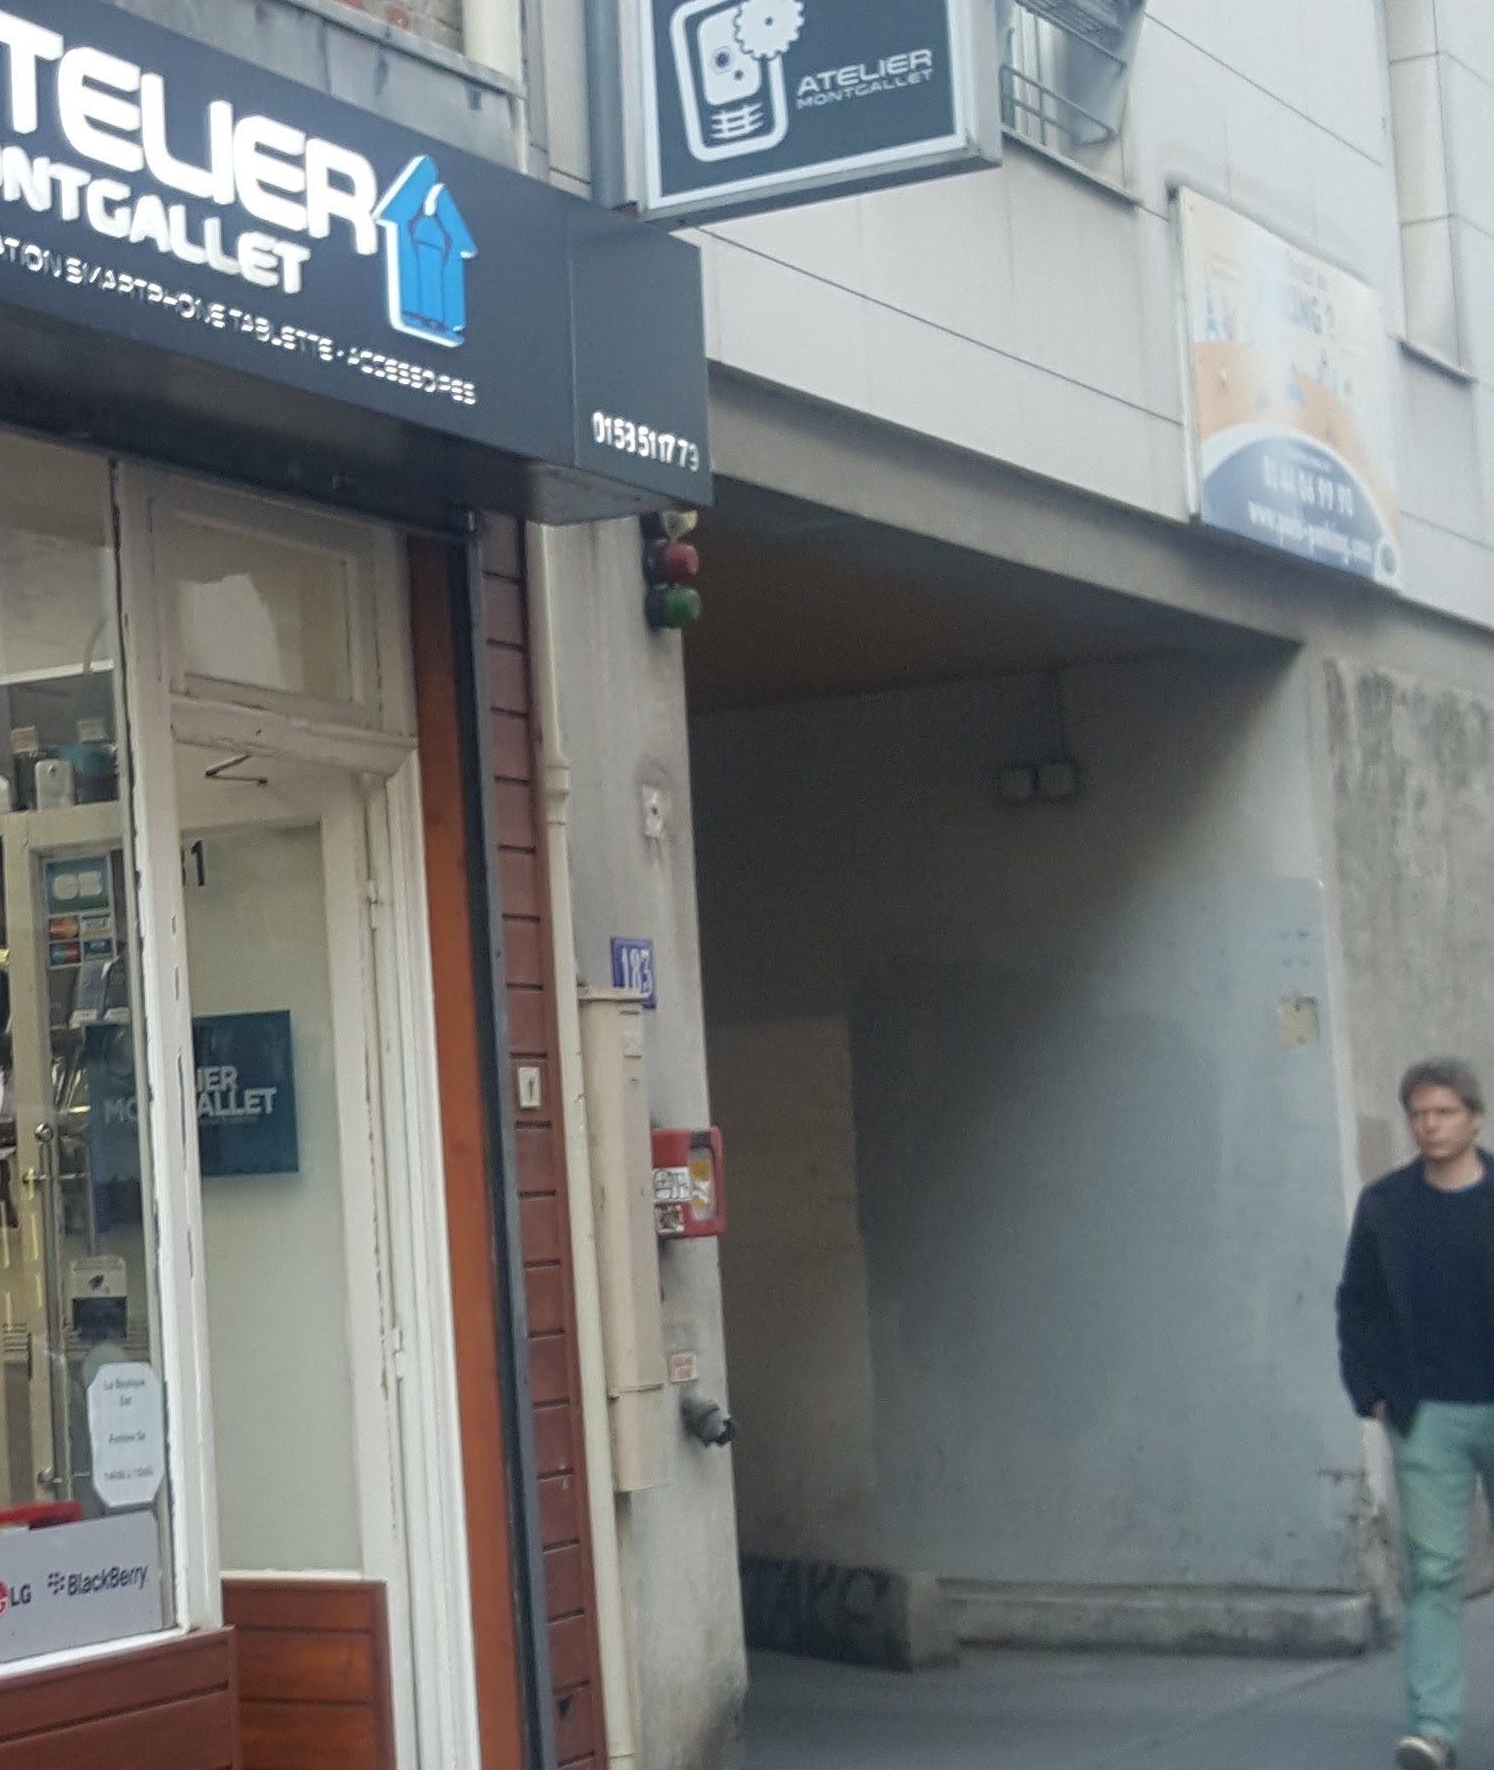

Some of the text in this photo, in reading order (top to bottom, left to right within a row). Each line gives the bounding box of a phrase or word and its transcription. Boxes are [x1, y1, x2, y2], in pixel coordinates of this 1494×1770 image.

[796, 49, 933, 97] ATELIER
[796, 68, 934, 111] MONTGALLET
[9, 1582, 32, 1608] LG
[66, 1563, 149, 1597] BlackBerry
